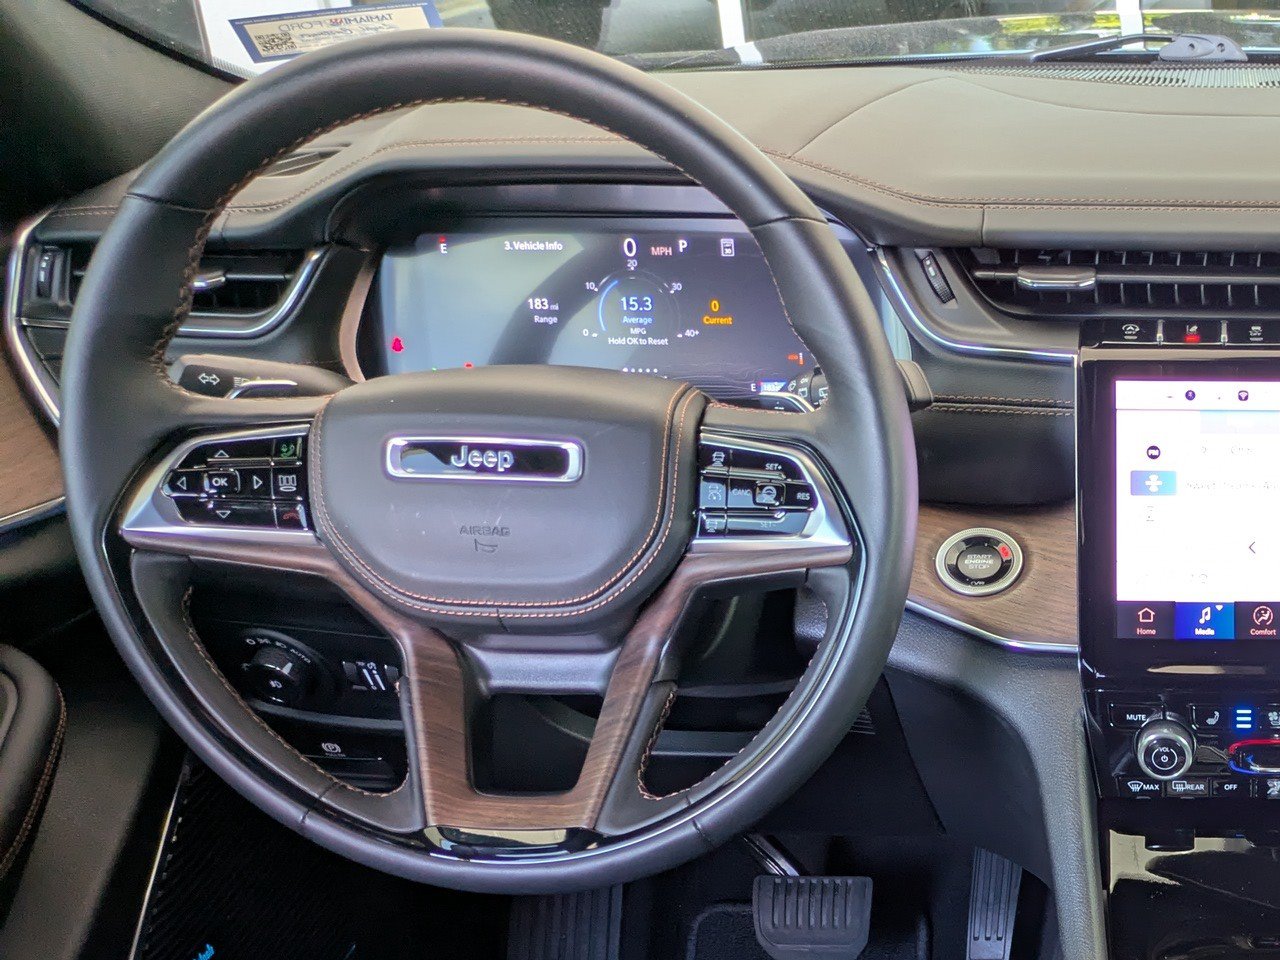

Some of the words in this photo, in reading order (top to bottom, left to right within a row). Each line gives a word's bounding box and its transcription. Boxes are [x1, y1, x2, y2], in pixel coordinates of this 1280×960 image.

[440, 243, 448, 254] E
[513, 241, 545, 251] Vehicle
[545, 241, 563, 251] Info
[623, 238, 637, 257] 0
[651, 246, 673, 256] MPH
[678, 240, 688, 252] P
[627, 259, 638, 267] 20
[585, 282, 595, 290] 10
[672, 283, 682, 291] 30
[527, 298, 549, 311] 183
[550, 303, 559, 311] mi
[620, 296, 653, 312] 15.3
[711, 301, 720, 312] 0
[534, 315, 558, 325] Range
[622, 316, 652, 325] Average
[703, 316, 733, 325] Current
[685, 329, 699, 337] 40+
[608, 337, 626, 346] Hold
[627, 337, 639, 346] OK
[639, 337, 647, 346] to
[648, 337, 669, 346] Reset
[451, 445, 514, 472] Jeep
[212, 477, 228, 487] OK
[796, 493, 810, 501] RES
[459, 526, 511, 536] AIRBAG
[1195, 628, 1215, 636] Media
[1250, 628, 1277, 636] Comfort
